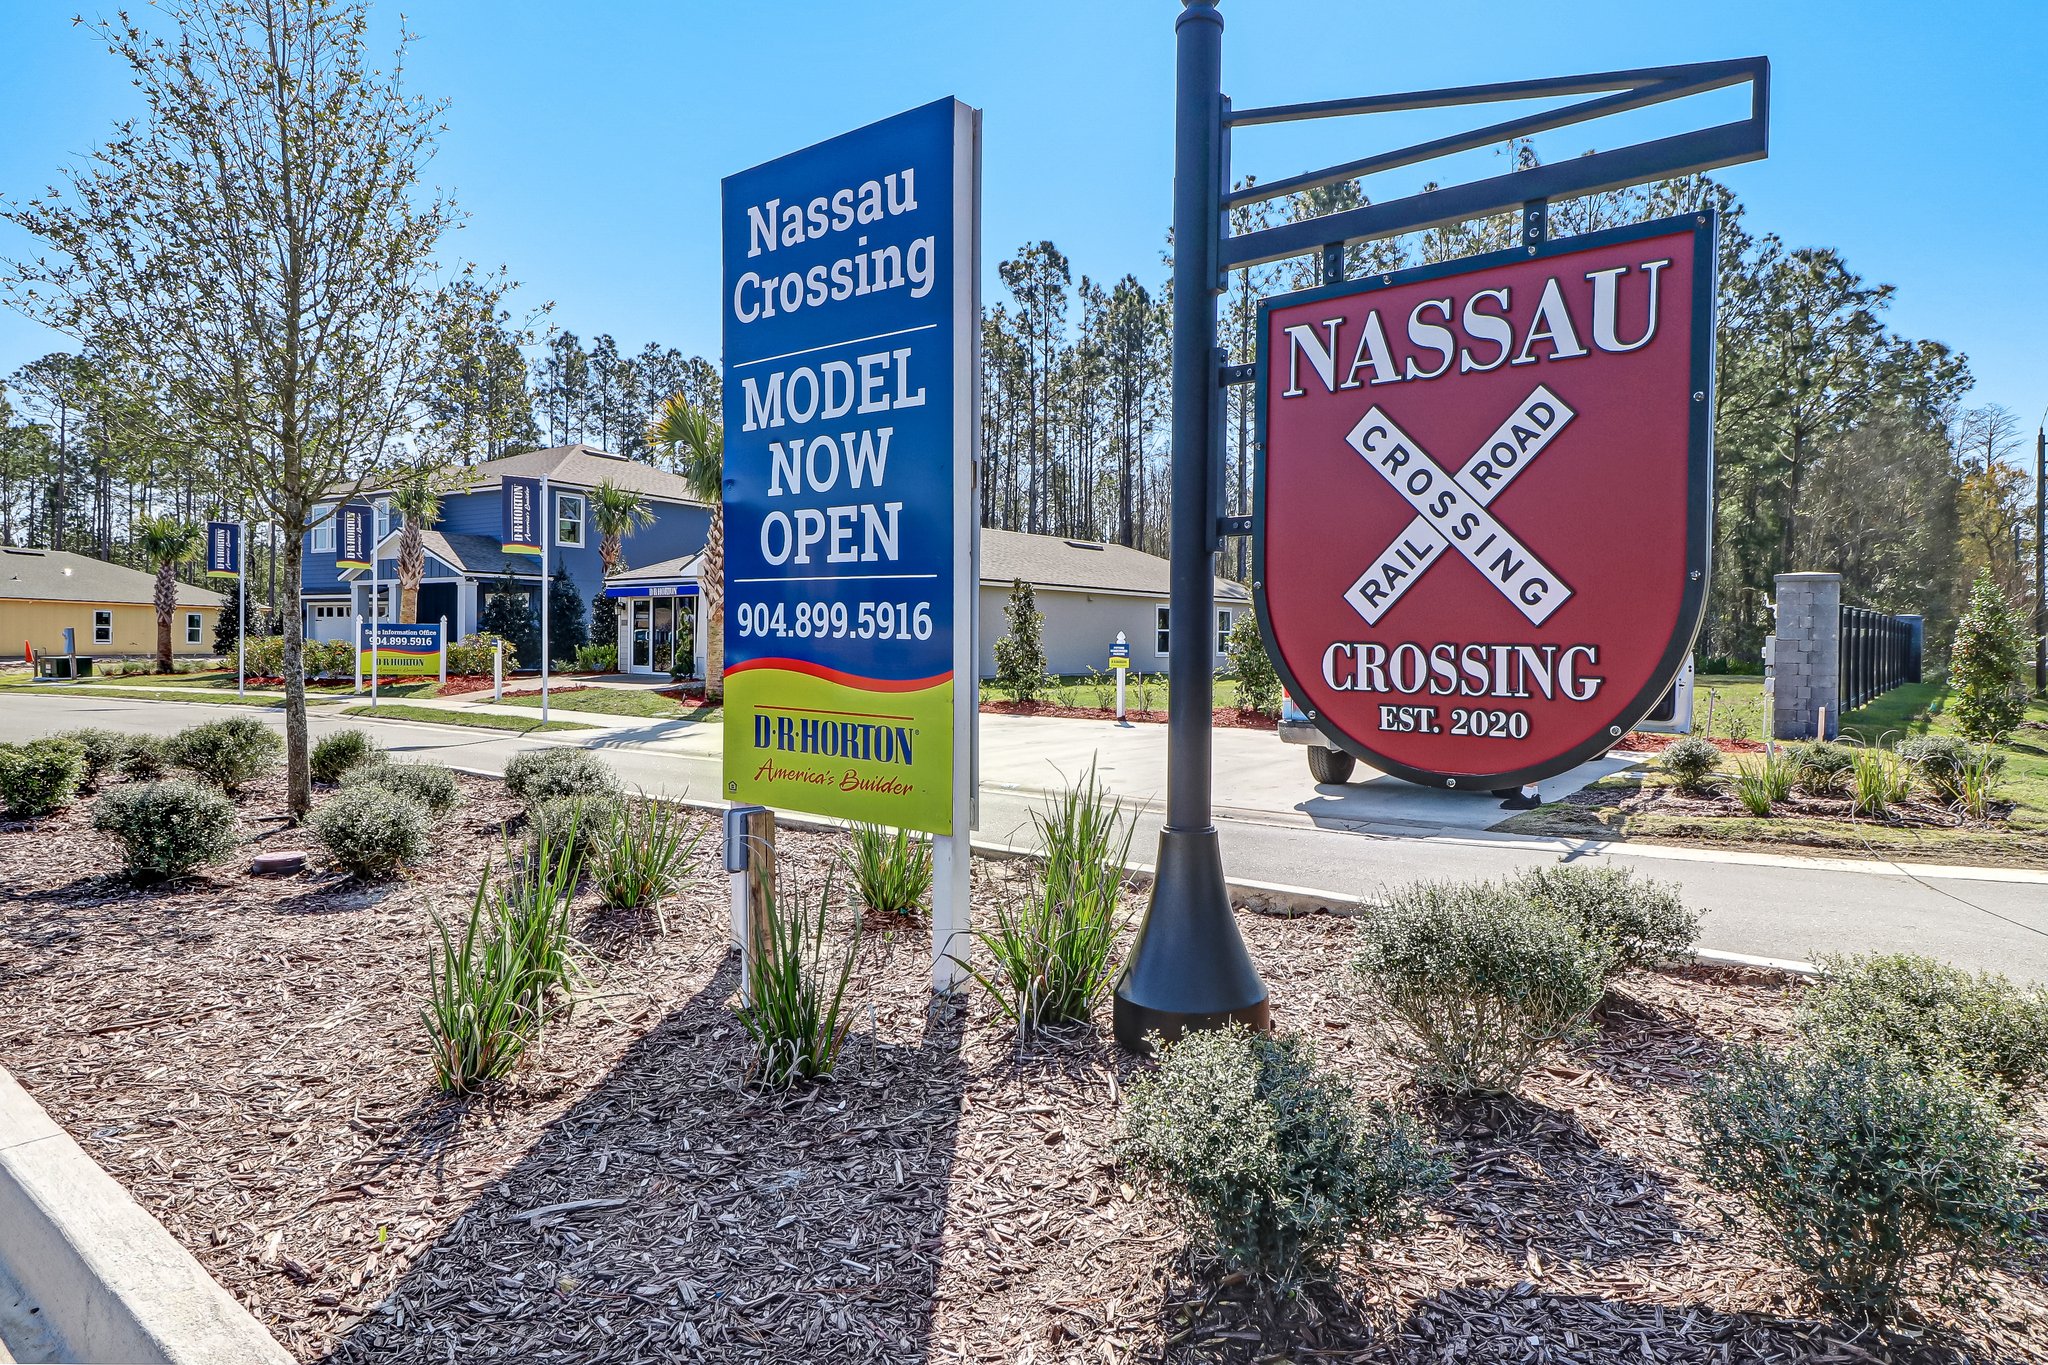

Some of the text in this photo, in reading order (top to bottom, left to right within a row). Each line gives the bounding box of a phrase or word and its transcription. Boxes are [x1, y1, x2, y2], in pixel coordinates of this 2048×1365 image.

[747, 167, 918, 259] Nassau
[733, 235, 935, 324] Crossing
[1281, 258, 1671, 399] NASSAU
[741, 347, 926, 432] MODEL
[767, 427, 894, 497] NOW
[760, 501, 903, 566] OPEN
[1359, 401, 1556, 609] RAIL ROAD
[1361, 424, 1549, 607] CROSSING
[737, 601, 933, 641] 904.899.5916
[1321, 642, 1602, 701] CROSSING
[1378, 705, 1529, 740] EST. 2020
[754, 757, 914, 796] America's Builder
